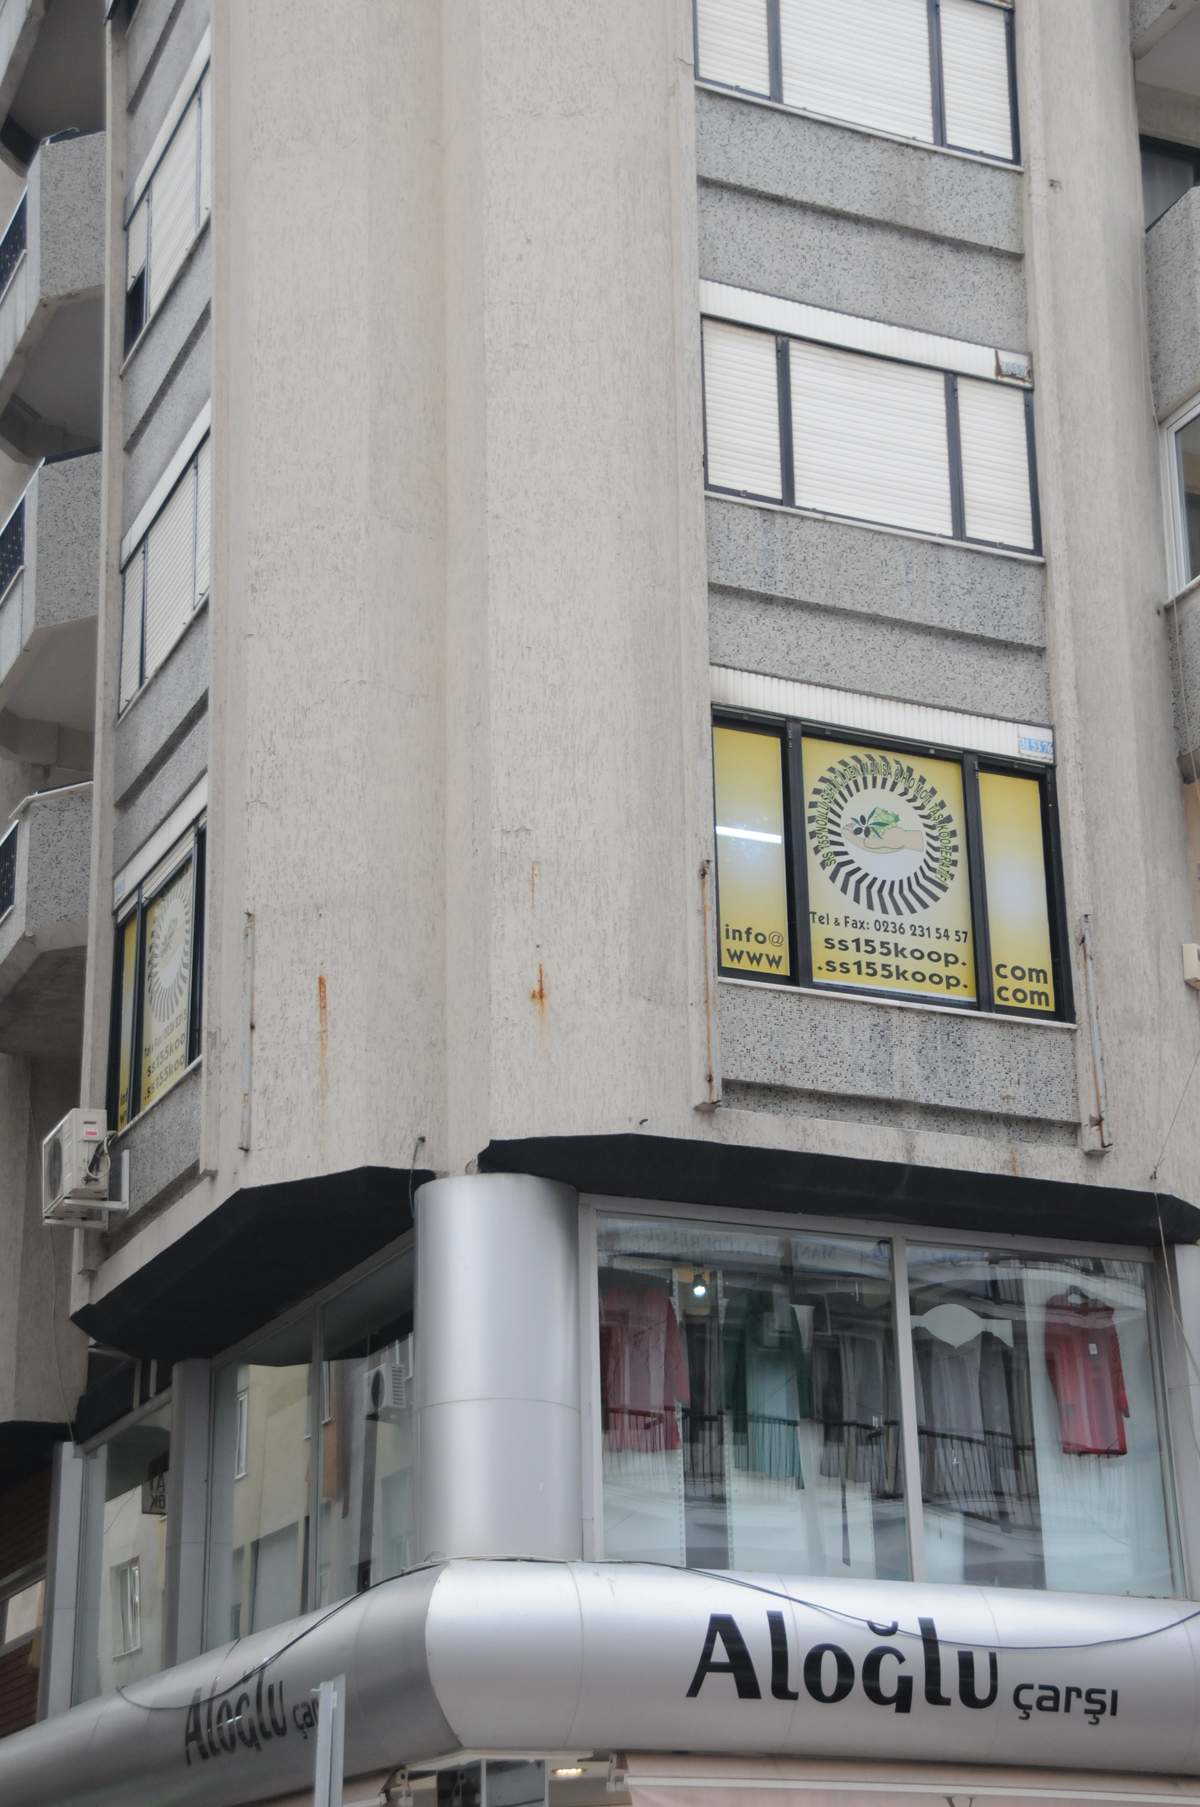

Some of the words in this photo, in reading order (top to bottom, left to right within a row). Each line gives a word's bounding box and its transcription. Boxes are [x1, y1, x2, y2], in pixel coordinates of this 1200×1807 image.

[724, 924, 784, 947] info@
[824, 937, 968, 967] ss155koop.
[995, 962, 1049, 985] com
[810, 911, 830, 925] Tel
[834, 917, 841, 927] &
[844, 915, 870, 930] Fax:
[874, 919, 906, 936] 0236
[910, 924, 931, 939] 231
[935, 927, 950, 941] 54
[955, 930, 968, 943] 57
[726, 948, 783, 969] www
[996, 984, 1050, 1007] com
[686, 1609, 999, 1714] Aloğlu
[1012, 1682, 1119, 1726] çarşı
[292, 1696, 319, 1740] çar
